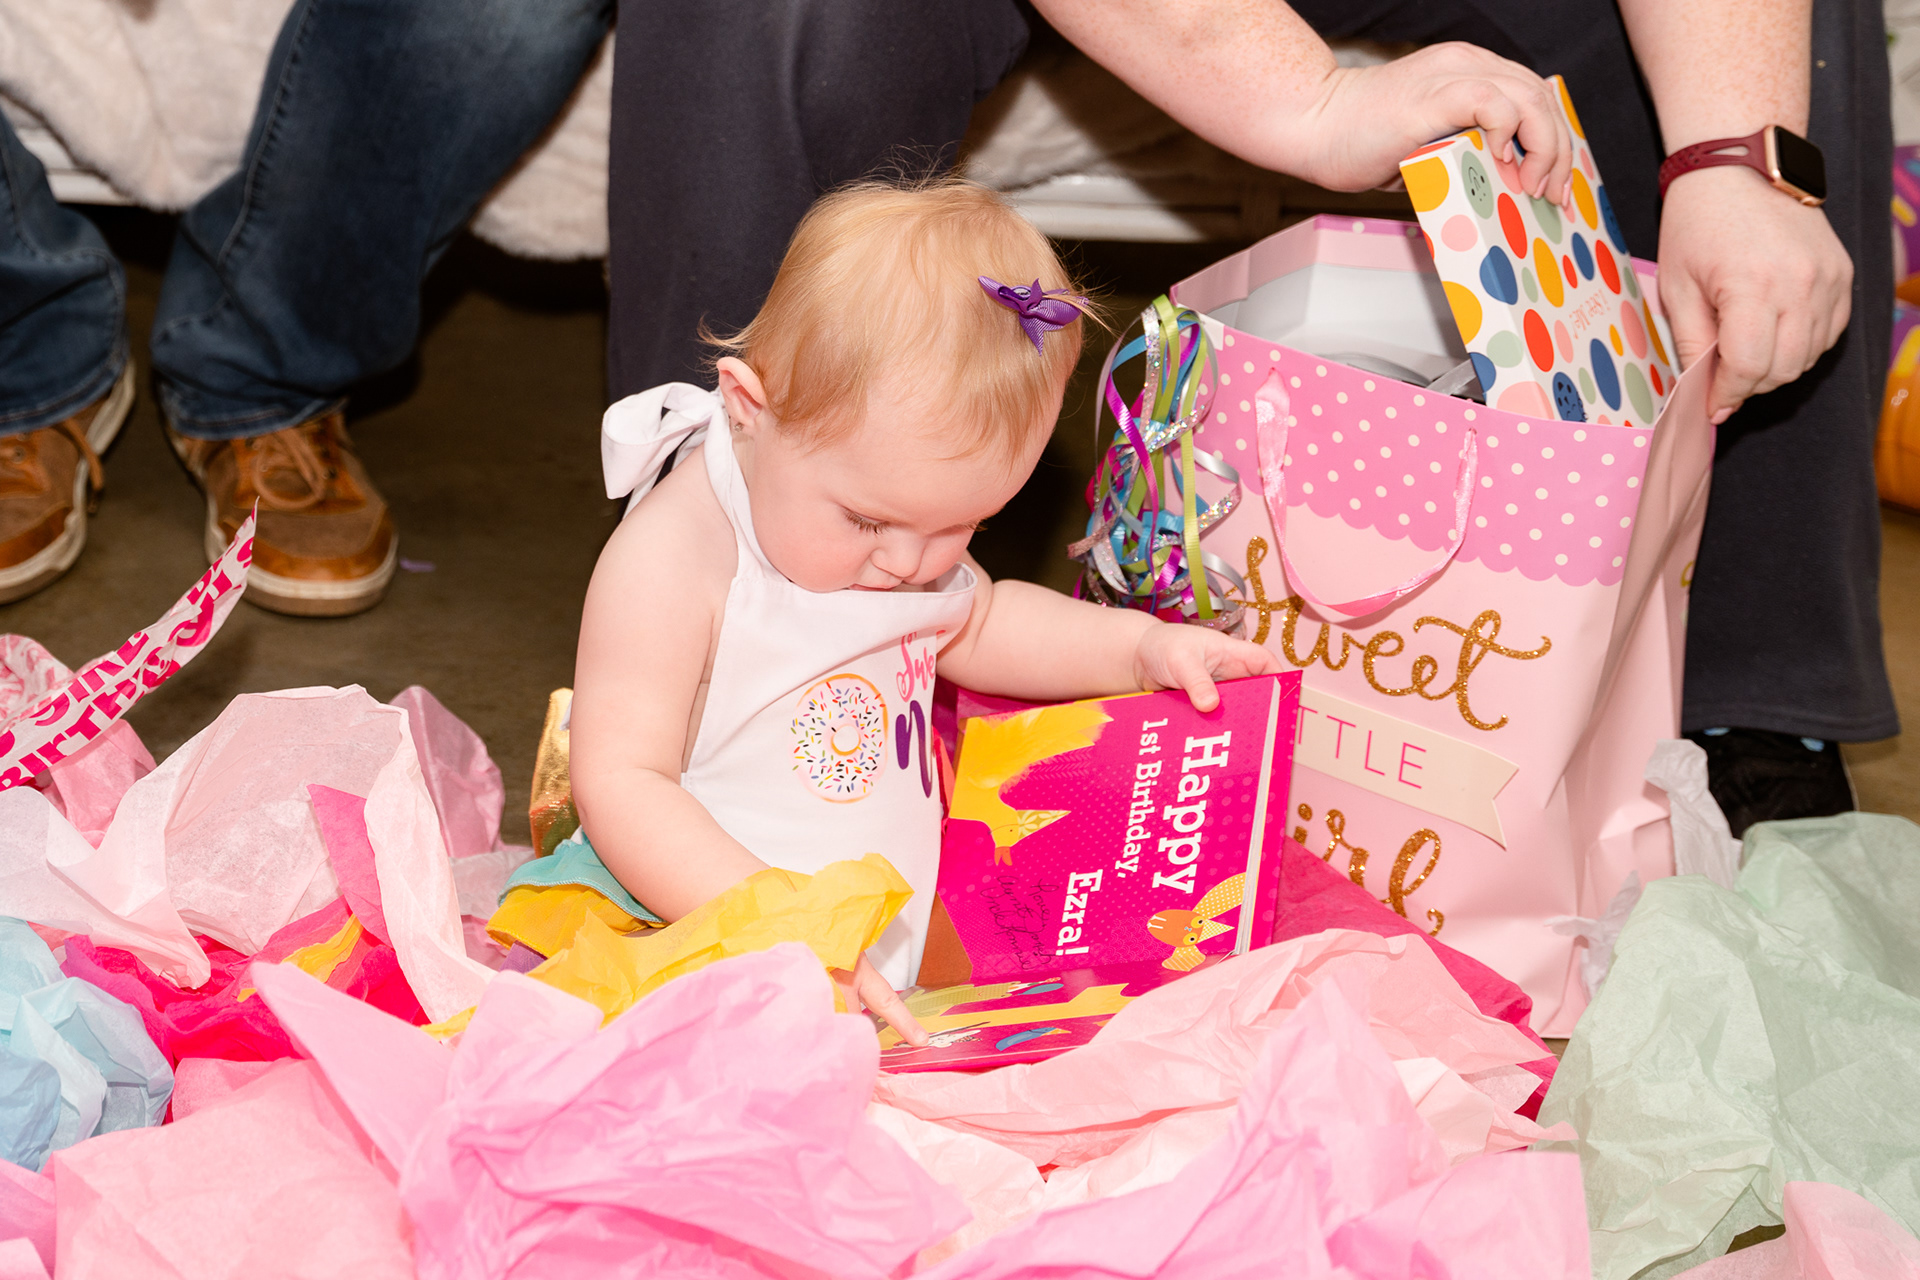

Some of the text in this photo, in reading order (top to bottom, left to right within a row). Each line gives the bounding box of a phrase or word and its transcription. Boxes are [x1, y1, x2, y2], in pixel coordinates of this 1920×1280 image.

[1115, 717, 1169, 879] 1st Birthday,
[1153, 730, 1232, 894] Happy
[1297, 704, 1428, 790] TTLE
[1056, 868, 1104, 956] Ezra!
[1293, 802, 1445, 937] irl
